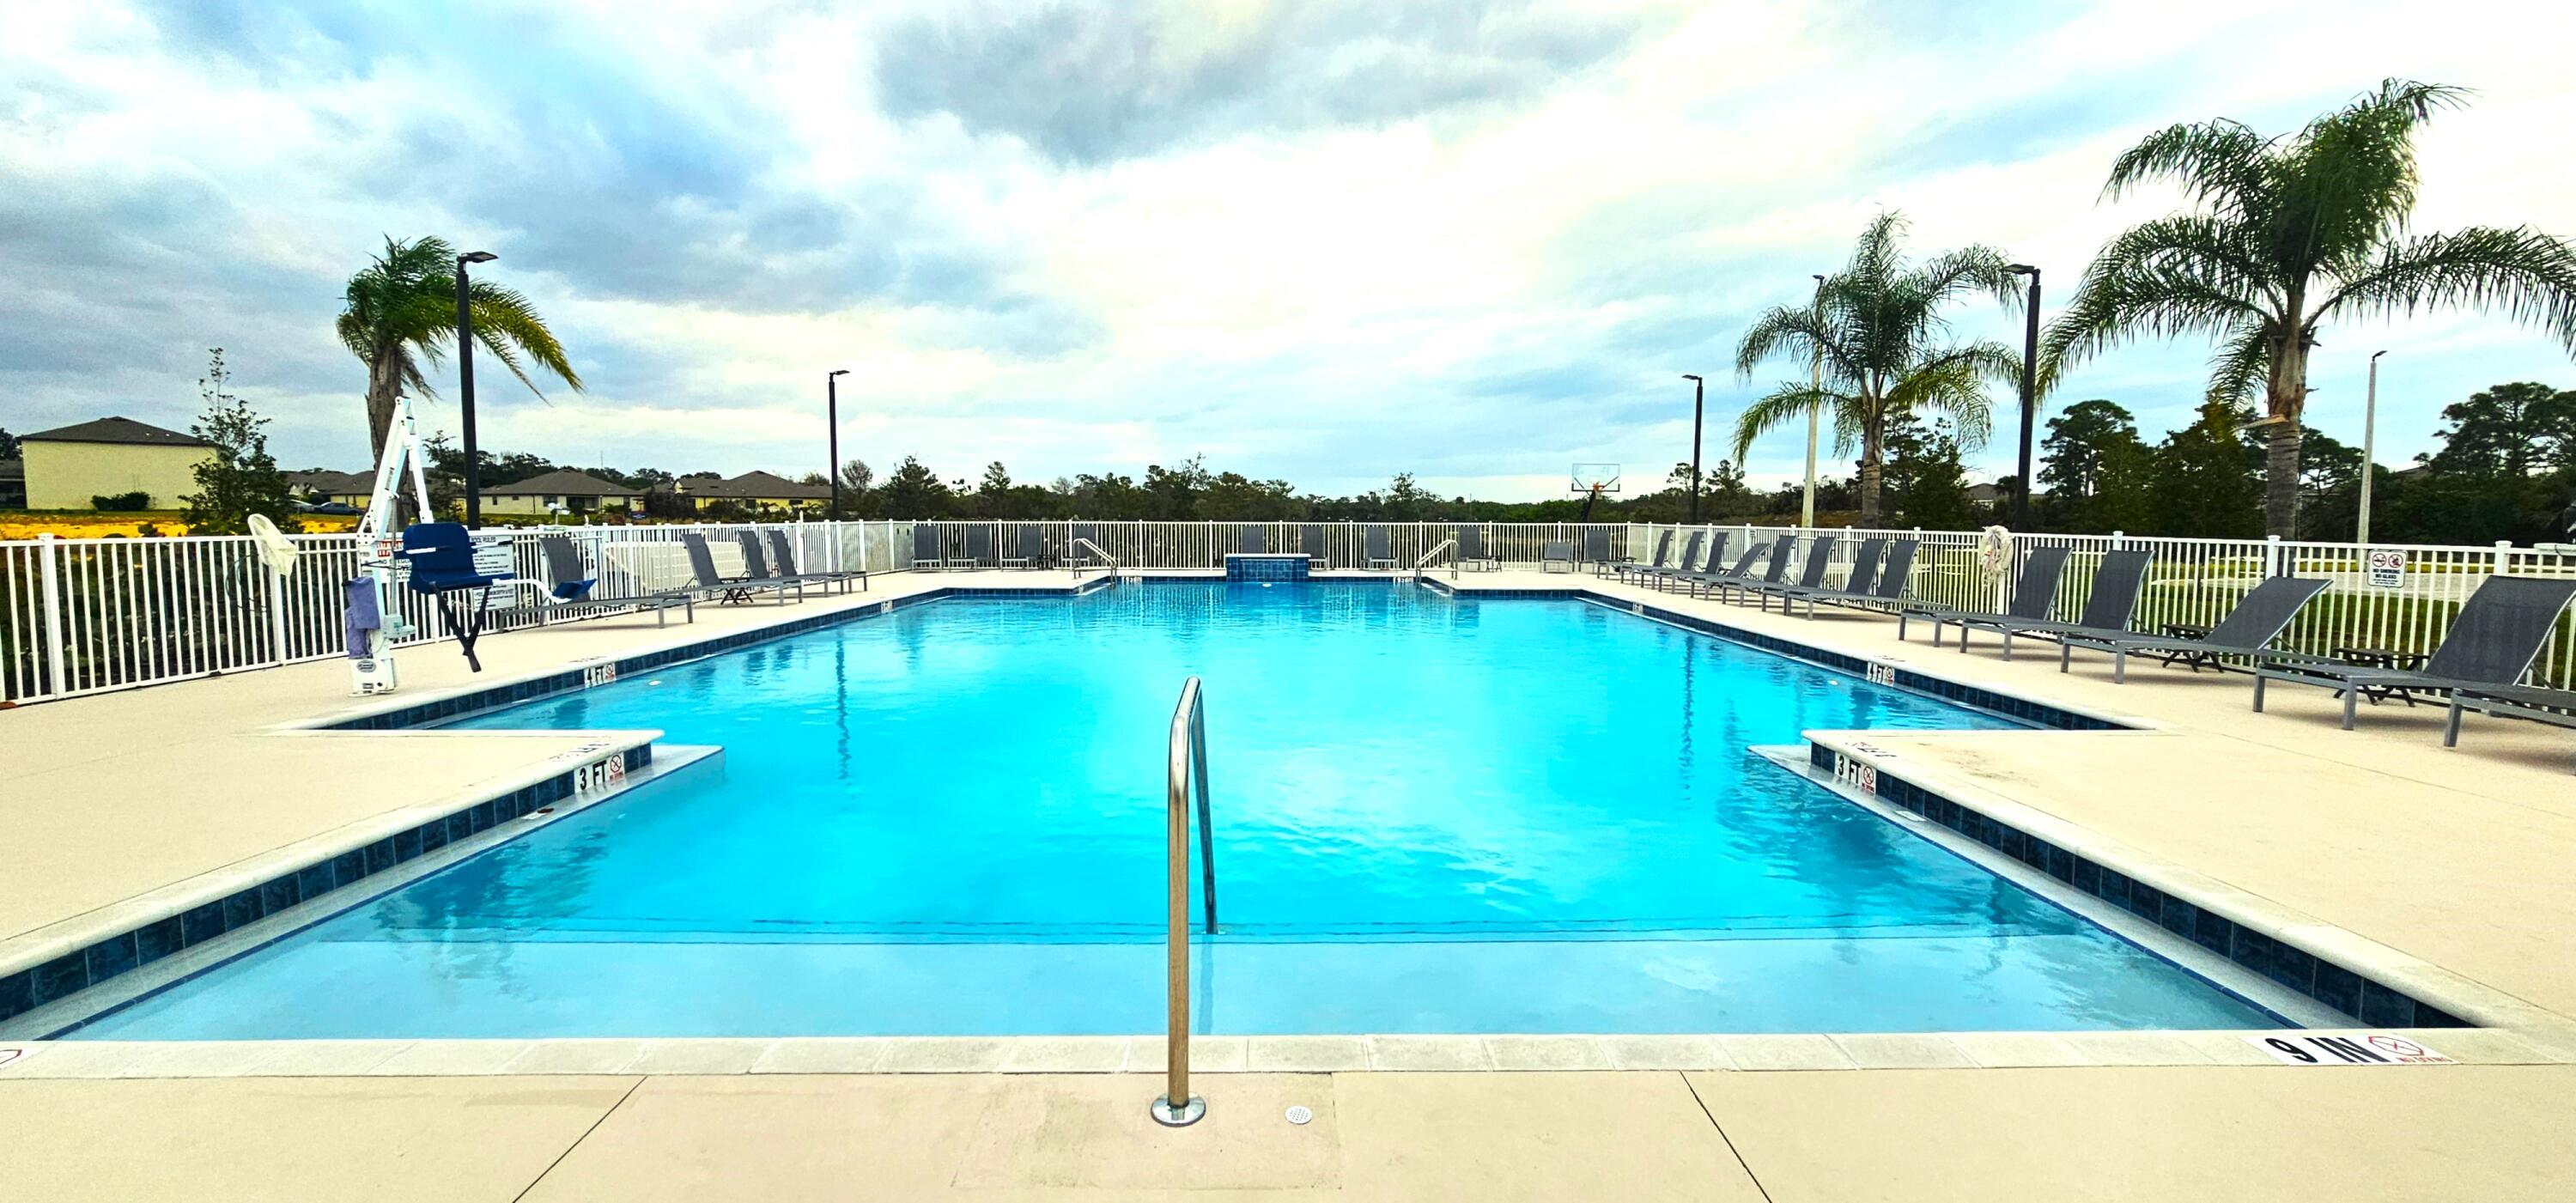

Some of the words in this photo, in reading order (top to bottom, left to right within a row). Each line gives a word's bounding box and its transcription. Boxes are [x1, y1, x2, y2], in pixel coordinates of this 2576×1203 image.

[587, 668, 592, 688] 4
[595, 665, 605, 684] FT
[1869, 662, 1874, 681] 4
[1876, 665, 1885, 684] FT
[579, 768, 587, 791] 3
[592, 759, 607, 786] FT
[1838, 755, 1845, 776] 3
[1849, 759, 1862, 784] FT
[2264, 1037, 2318, 1063] 9
[2303, 1036, 2391, 1063] IN
